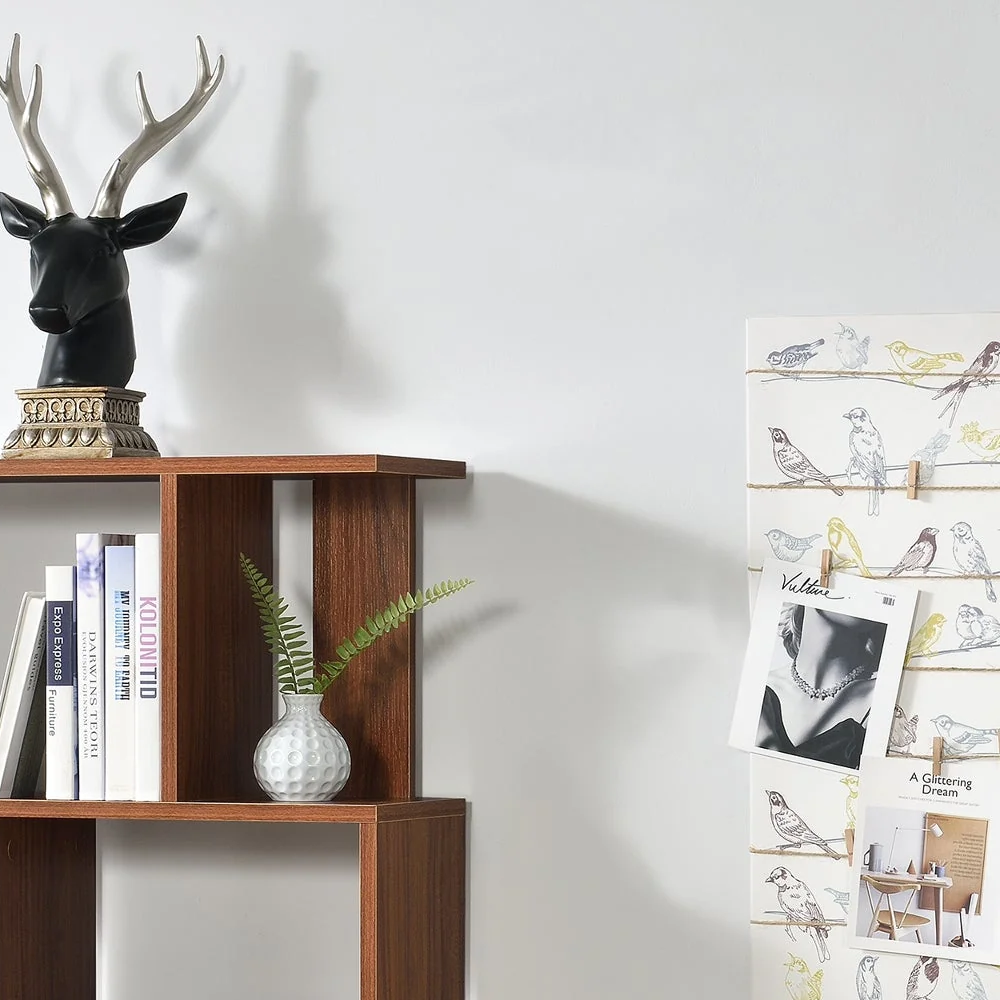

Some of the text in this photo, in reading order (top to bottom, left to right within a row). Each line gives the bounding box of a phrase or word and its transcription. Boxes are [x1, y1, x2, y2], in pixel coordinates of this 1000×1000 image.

[52, 606, 63, 681] Expo Express
[114, 590, 130, 701] MY JOURNEY TO EARTH
[139, 596, 157, 699] KOLONITID
[48, 689, 57, 737] Furniture
[89, 631, 98, 758] DARWINS TEORI
[909, 772, 972, 791] A Glittering
[922, 784, 958, 797] Dream
